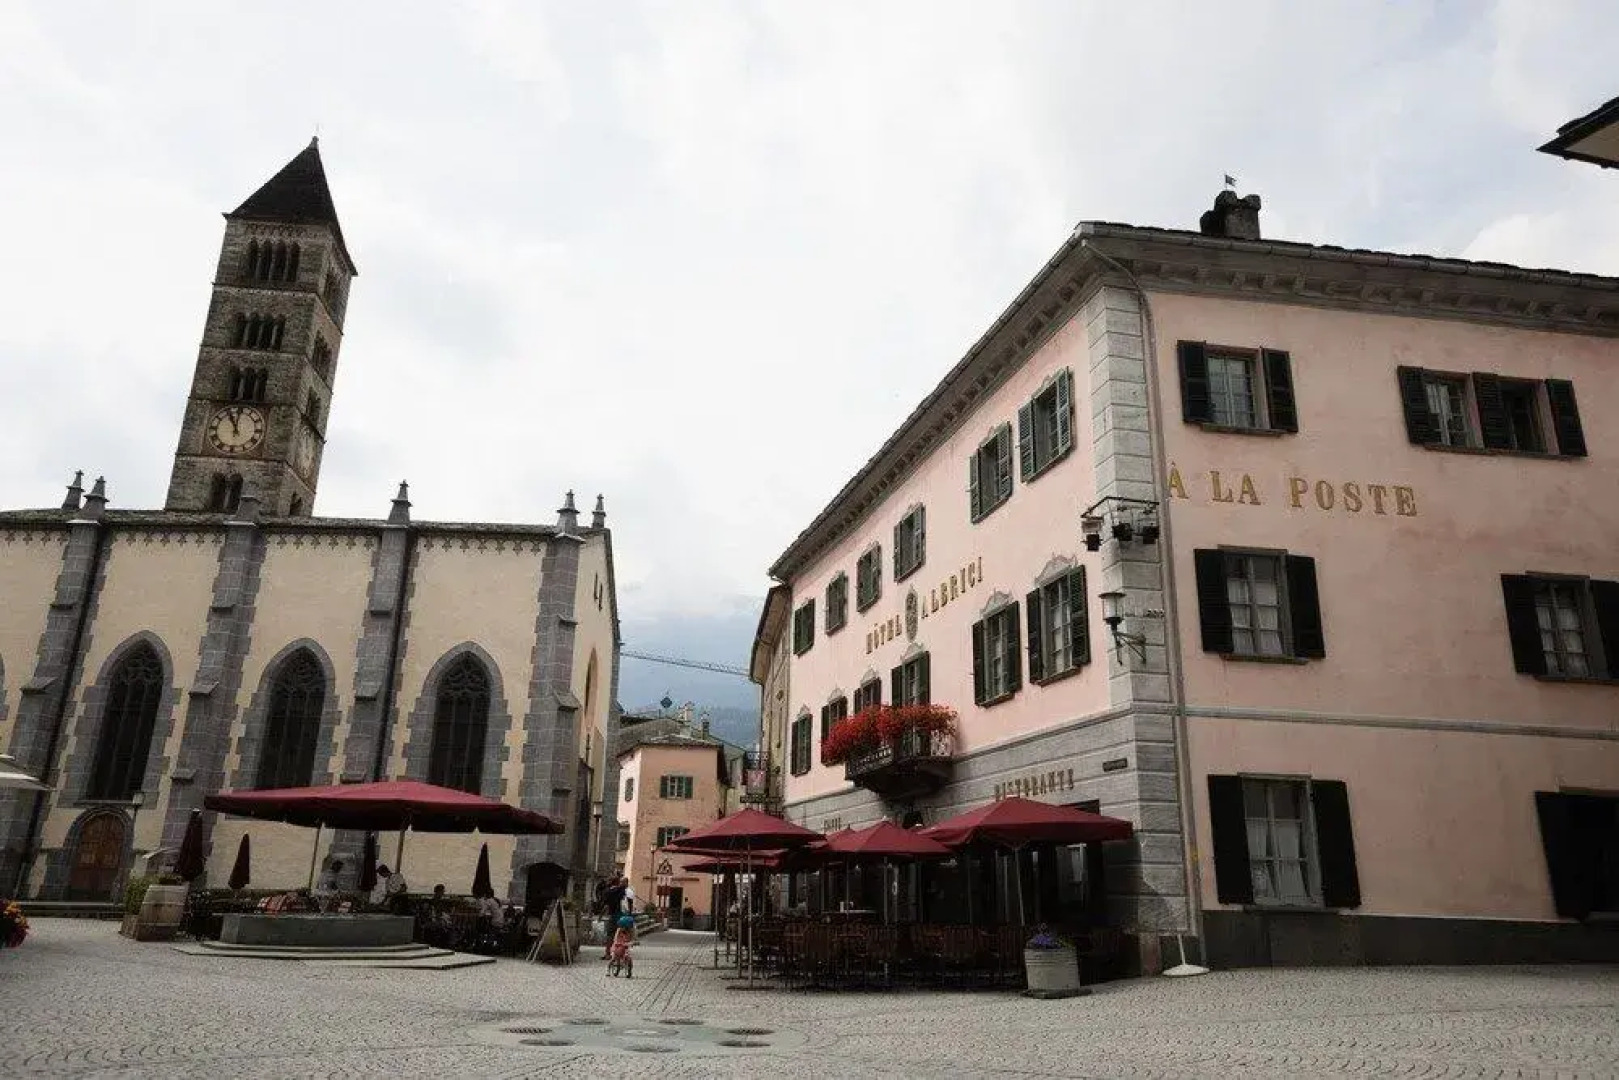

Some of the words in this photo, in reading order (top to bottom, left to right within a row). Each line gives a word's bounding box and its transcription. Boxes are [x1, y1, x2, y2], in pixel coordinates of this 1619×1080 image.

[1209, 470, 1262, 506] LA
[1288, 477, 1418, 518] POSTE
[920, 556, 984, 620] ALBRICI
